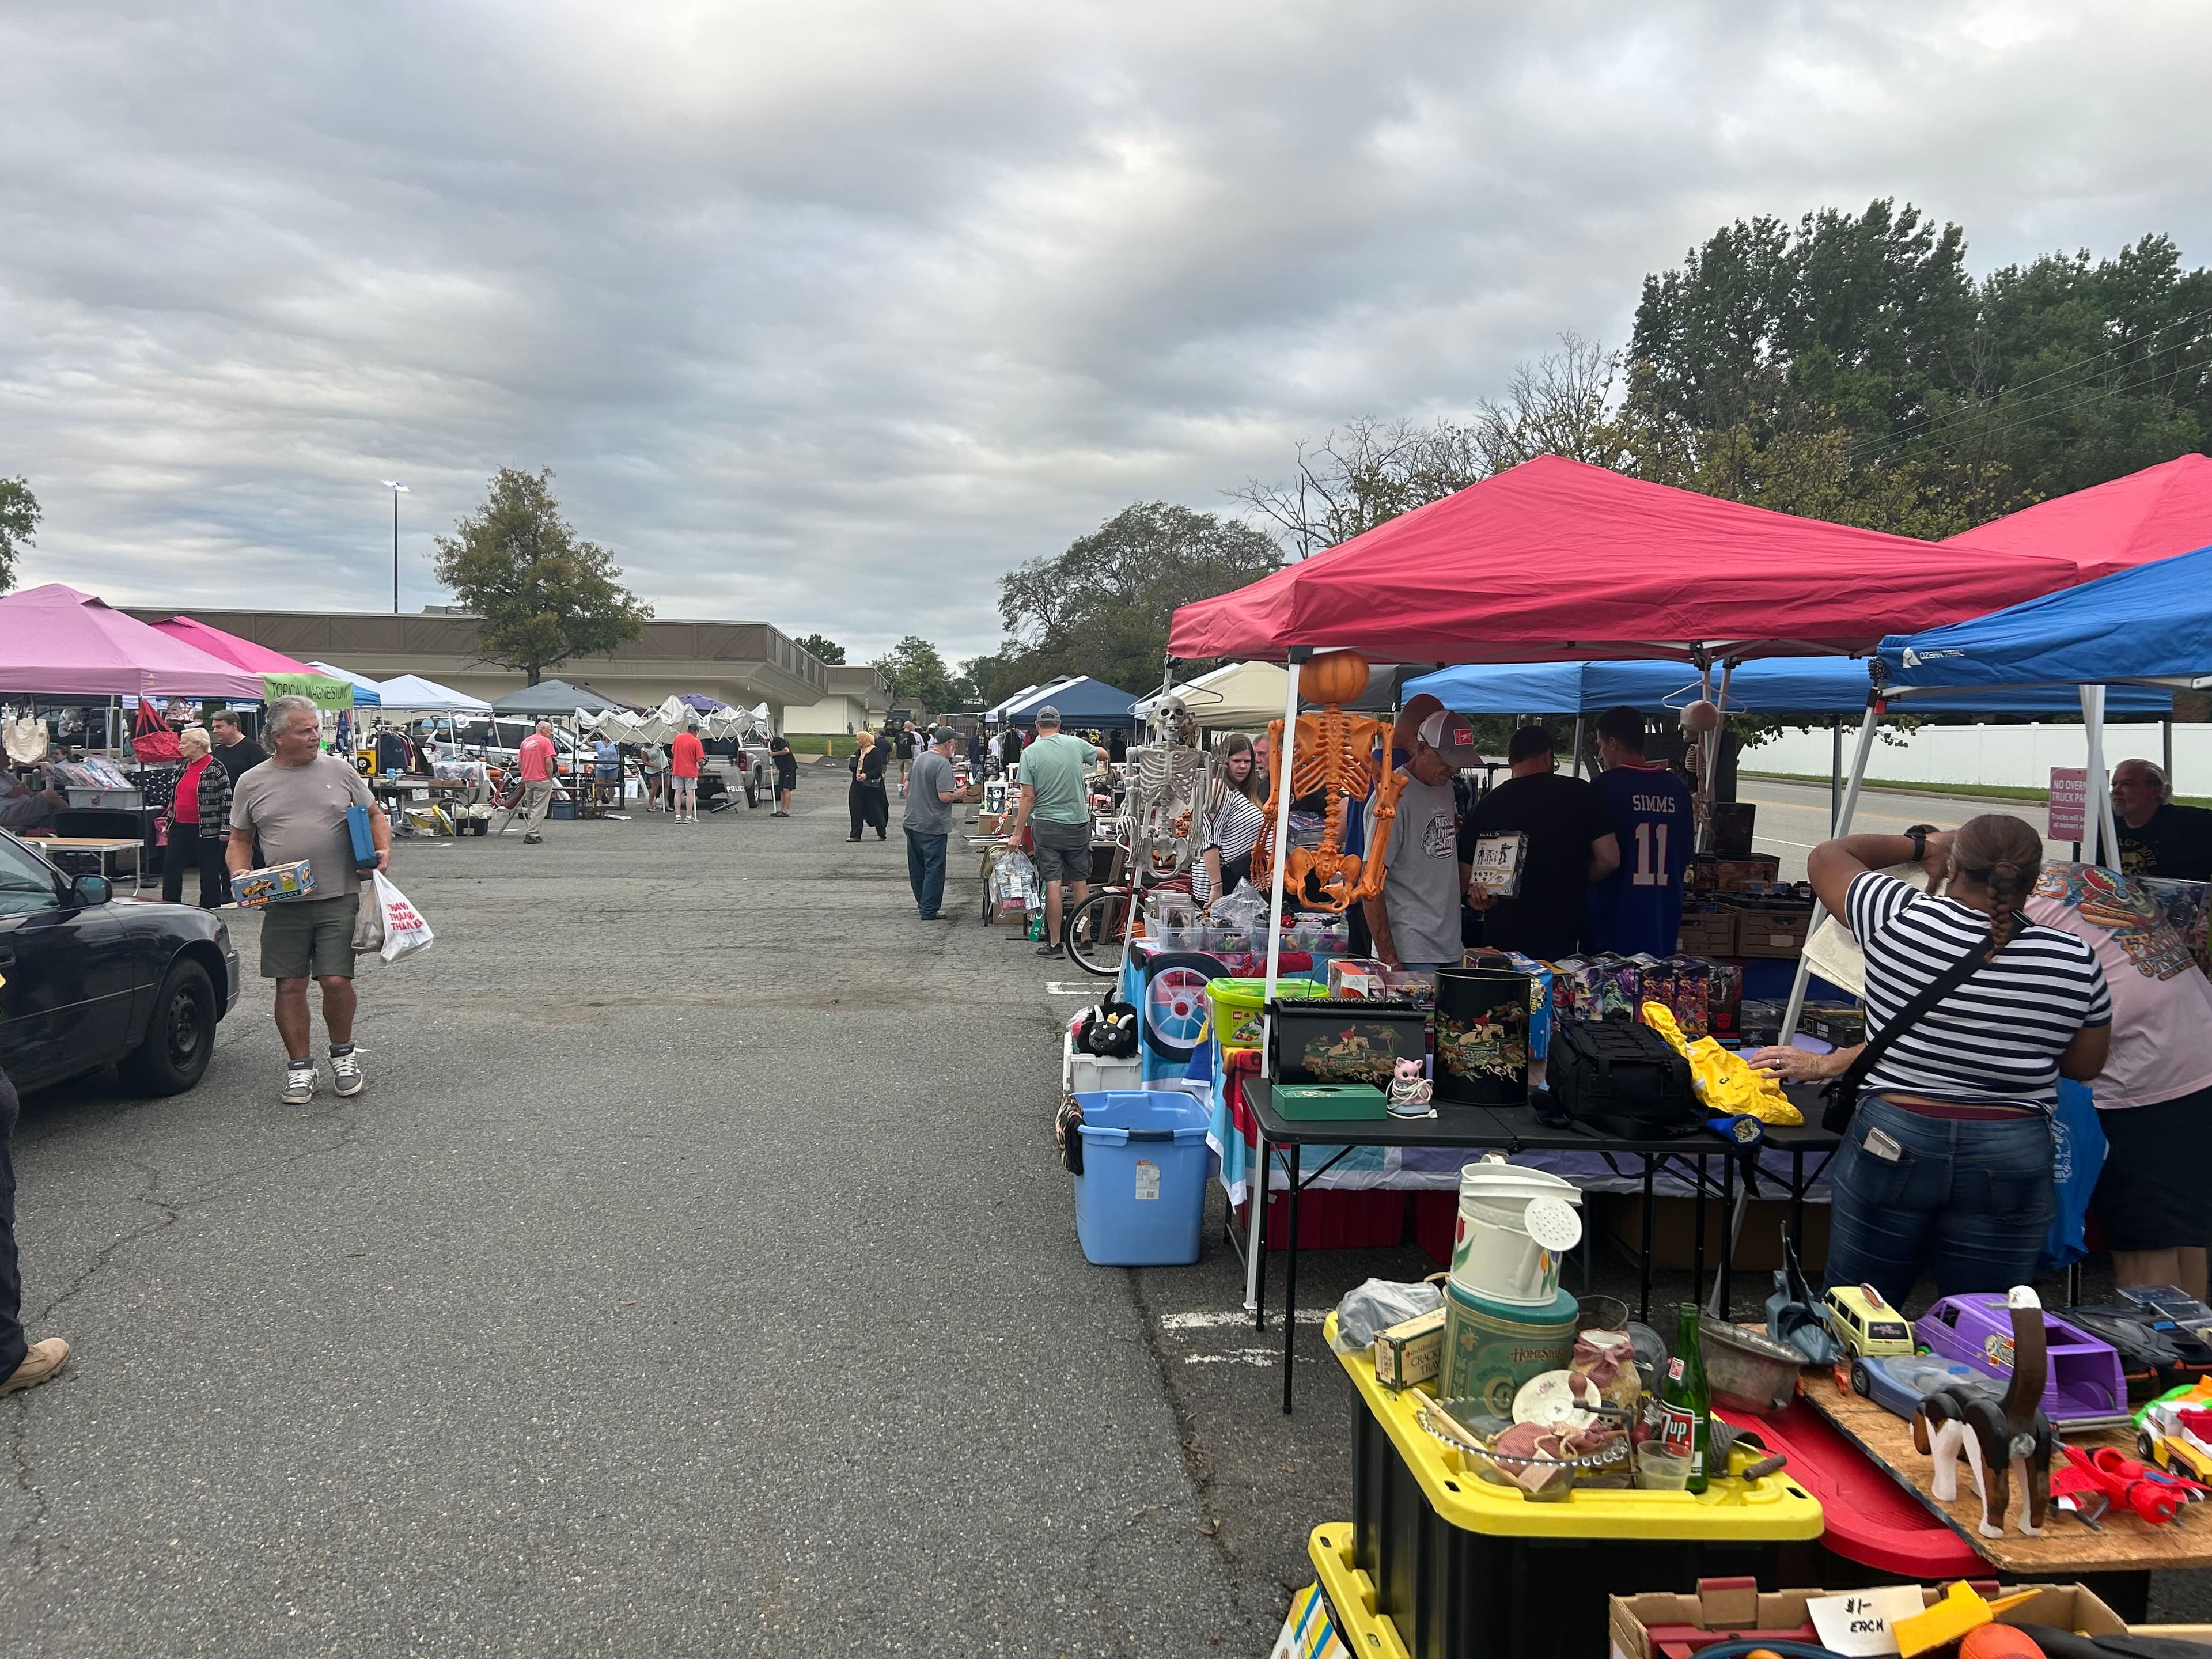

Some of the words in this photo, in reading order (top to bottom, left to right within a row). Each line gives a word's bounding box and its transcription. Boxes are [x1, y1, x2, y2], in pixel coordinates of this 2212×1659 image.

[271, 683, 304, 698] TOPICAL
[305, 685, 347, 700] MAGNESIUM
[2053, 779, 2064, 789] NO
[2065, 780, 2086, 791] OVERN
[1632, 794, 1676, 813] SIMMS
[2052, 792, 2073, 802] TRUCK
[1631, 821, 1669, 887] 11
[240, 896, 269, 907] SAND
[269, 891, 299, 901] BUGGY
[1850, 1617, 1884, 1633] EACH
